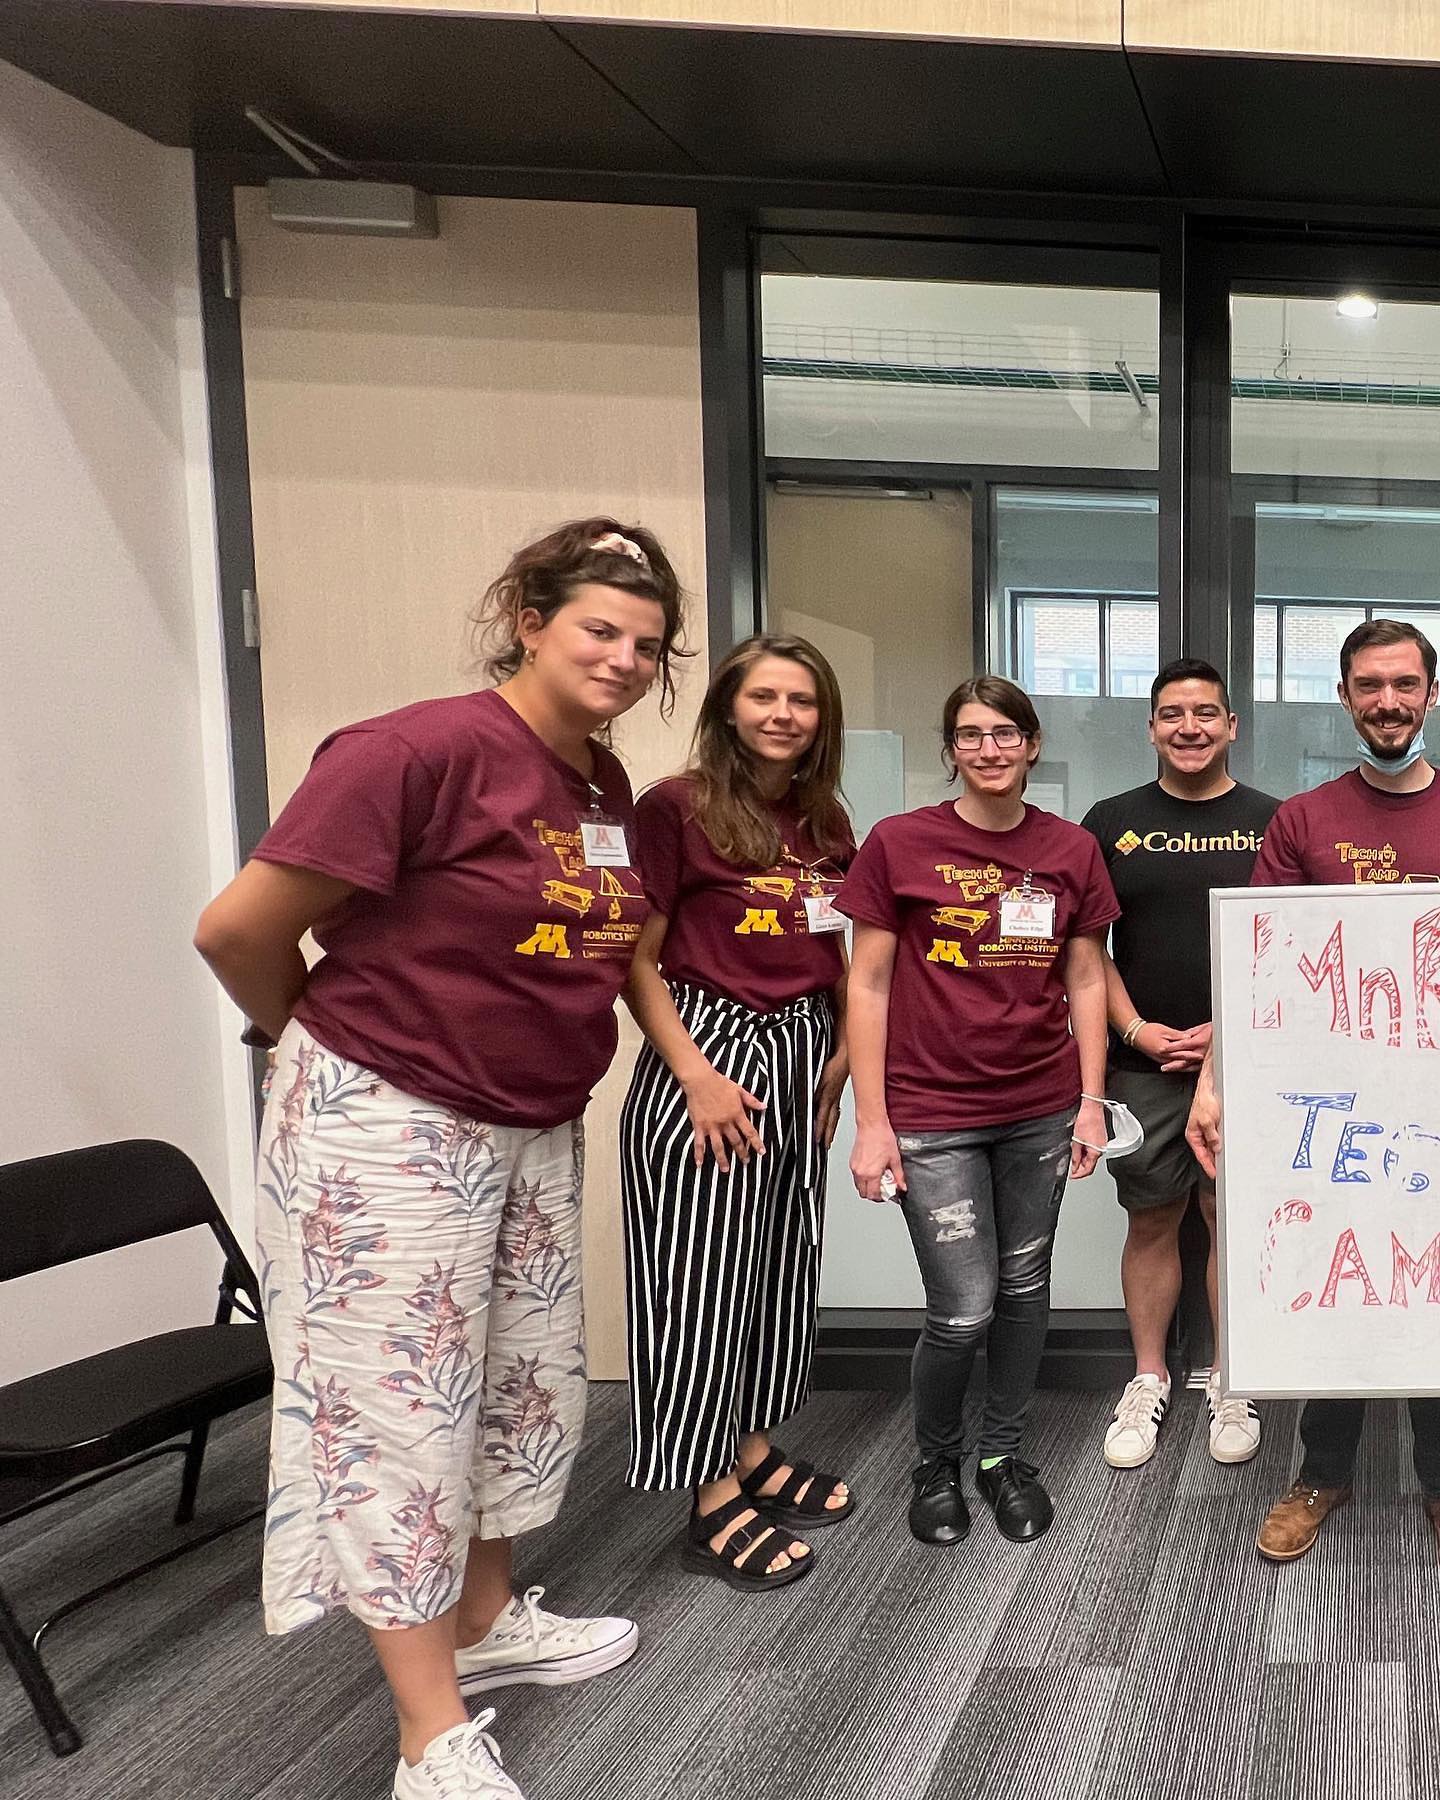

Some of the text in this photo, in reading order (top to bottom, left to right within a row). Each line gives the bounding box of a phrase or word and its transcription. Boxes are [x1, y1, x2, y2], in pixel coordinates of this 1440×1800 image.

[1335, 843, 1377, 863] TECH
[935, 864, 982, 884] TECH
[1353, 861, 1399, 885] CAMP
[959, 880, 1007, 902] CAMP
[735, 908, 784, 936] M
[515, 922, 571, 959] M
[583, 930, 623, 940] ROBOTICS
[926, 938, 969, 968] M
[978, 944, 1023, 952] ROBOTICS
